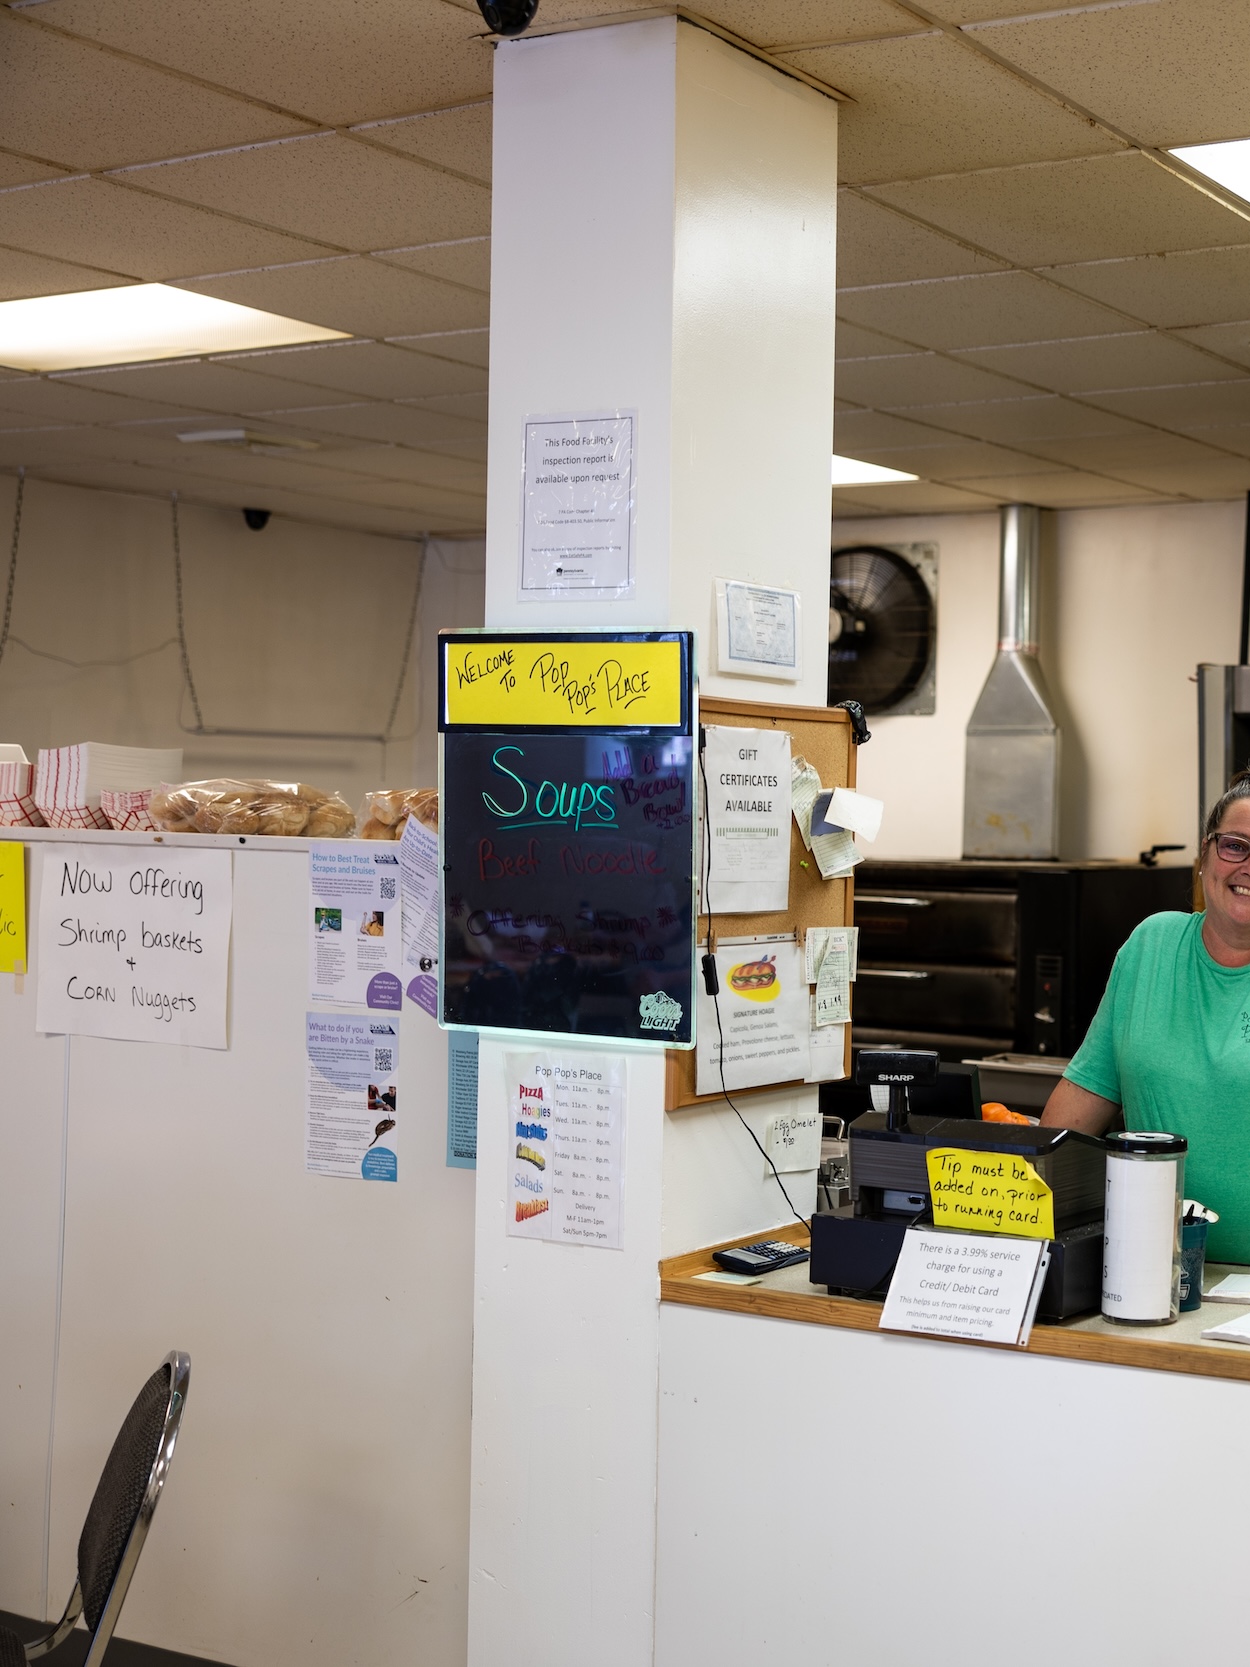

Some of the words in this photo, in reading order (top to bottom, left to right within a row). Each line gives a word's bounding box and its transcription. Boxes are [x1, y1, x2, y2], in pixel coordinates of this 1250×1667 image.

[545, 439, 559, 447] This
[562, 437, 580, 446] Food
[543, 456, 581, 466] inspection
[583, 455, 606, 465] report
[608, 454, 613, 462] is
[536, 475, 568, 484] available
[571, 475, 589, 484] upon
[592, 473, 619, 484] request
[456, 650, 515, 689] WELCOME
[739, 749, 757, 760] GIFT
[481, 745, 617, 831] Soups
[720, 774, 777, 787] CERTIFICATES
[726, 800, 772, 812] AVAILABLE
[479, 837, 541, 880] Beef
[560, 843, 666, 875] Noodle
[313, 864, 336, 873] Scrapes
[352, 866, 375, 875] Bruises
[129, 867, 204, 915] Offering
[58, 918, 127, 952] Shrimp
[141, 920, 203, 954] baskets
[131, 986, 196, 1023] Nuggets
[733, 1010, 758, 1018] SIGNATURE
[309, 1023, 326, 1031] What
[641, 1017, 680, 1030] LIGHT
[320, 1034, 339, 1042] Bitten
[341, 1035, 348, 1045] by
[356, 1036, 374, 1045] Snake
[535, 1066, 552, 1077] Pop
[554, 1068, 577, 1079] Pop's
[580, 1070, 602, 1081] Place
[520, 1084, 543, 1101] PIZZA
[522, 1103, 551, 1119] Hoagies
[780, 1120, 789, 1136] Egg
[791, 1117, 816, 1129] Omelet
[555, 1152, 570, 1160] Friday
[934, 1154, 962, 1178] Tip
[972, 1164, 1004, 1178] must
[1013, 1163, 1029, 1181] be
[515, 1173, 543, 1193] Salads
[934, 1179, 974, 1195] added
[1007, 1189, 1047, 1206] prior
[575, 1203, 596, 1212] Delivery
[934, 1197, 948, 1212] to
[955, 1203, 1003, 1226] running
[1009, 1208, 1043, 1224] card.
[578, 1217, 604, 1225] 11am-1pm
[563, 1228, 582, 1236] Sat/Sun
[583, 1230, 607, 1239] 5pm-7pm
[919, 1242, 943, 1254] There
[945, 1244, 952, 1254] is
[962, 1247, 988, 1258] 3.99%
[990, 1251, 1021, 1261] service
[926, 1261, 956, 1274] charge
[957, 1264, 970, 1274] for
[972, 1266, 996, 1278] using
[997, 1269, 1003, 1277] a
[919, 1279, 952, 1292] Credit/
[953, 1283, 976, 1294] Debit
[978, 1285, 999, 1296] Card
[900, 1295, 912, 1304] This
[913, 1297, 931, 1307] helps
[941, 1300, 957, 1309] from
[959, 1302, 981, 1313] raising
[995, 1306, 1010, 1315] card
[906, 1310, 938, 1319] minimum
[939, 1312, 952, 1321] and
[953, 1313, 968, 1323] item
[969, 1316, 994, 1327] pricing.
